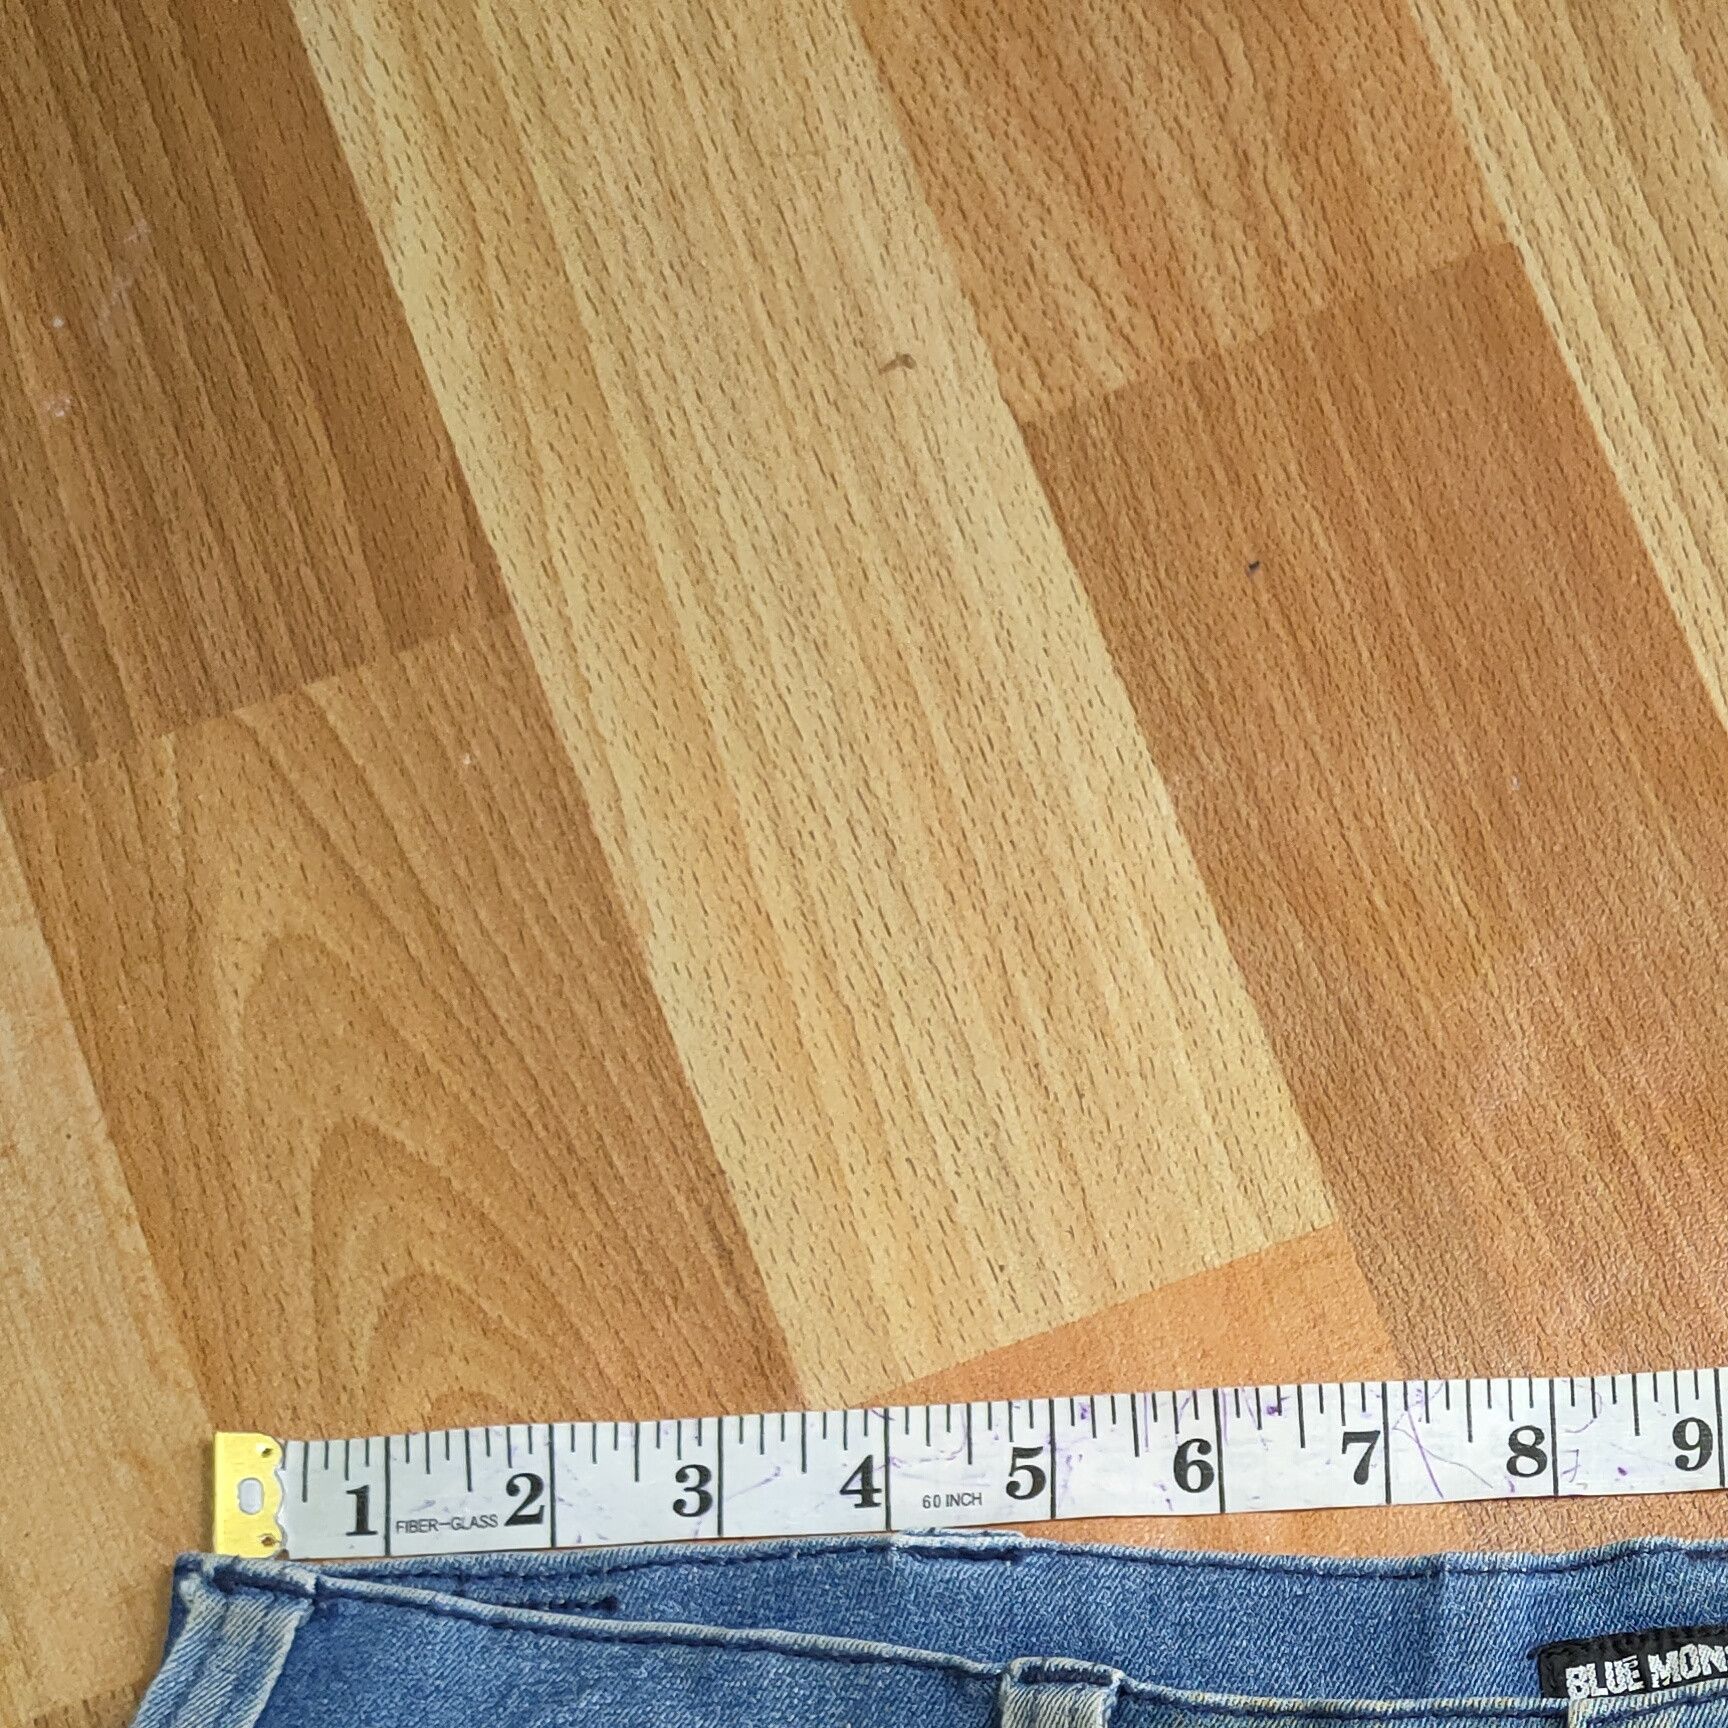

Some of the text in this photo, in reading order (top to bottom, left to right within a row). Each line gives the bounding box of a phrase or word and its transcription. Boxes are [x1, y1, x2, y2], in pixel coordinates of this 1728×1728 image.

[1173, 1438, 1214, 1493] 6
[1341, 1430, 1381, 1485] 7
[1506, 1425, 1548, 1478] 8
[1672, 1417, 1713, 1471] 9
[504, 1472, 545, 1526] 2
[672, 1464, 713, 1517] 3
[839, 1456, 882, 1509] 4
[1005, 1446, 1046, 1500] 5
[345, 1486, 379, 1536] 1
[395, 1514, 499, 1533] FIBER-GLASS
[922, 1492, 983, 1509] 60 INCH
[1566, 1655, 1644, 1700] BLUE
